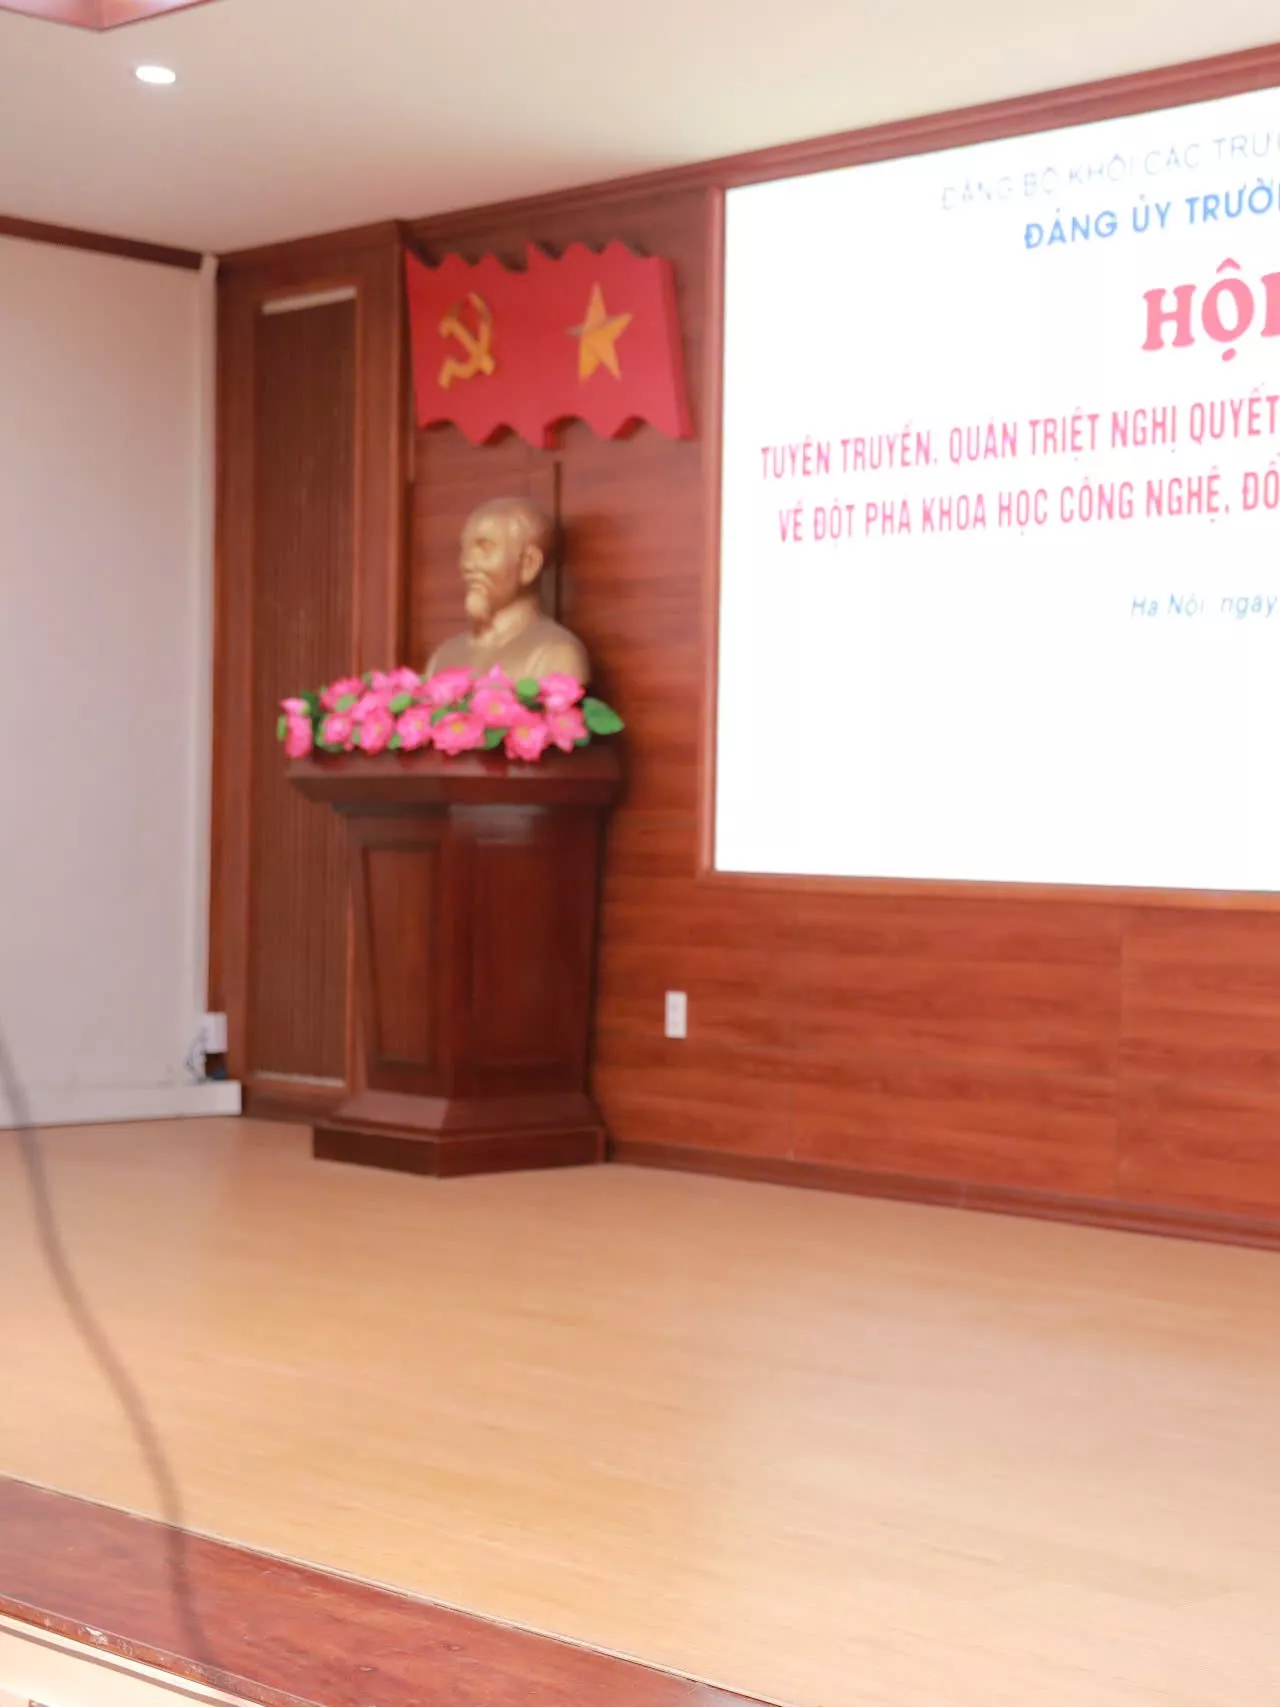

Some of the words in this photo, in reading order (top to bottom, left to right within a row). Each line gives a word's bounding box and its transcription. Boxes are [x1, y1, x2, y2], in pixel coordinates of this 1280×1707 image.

[1028, 405, 1100, 462] TRIỆT
[1111, 404, 1177, 454] NGHỊ
[1189, 381, 1280, 446] QUYẾT
[922, 493, 987, 534] KHOA
[998, 488, 1048, 536] HỌC
[1060, 476, 1134, 524] CÔNG
